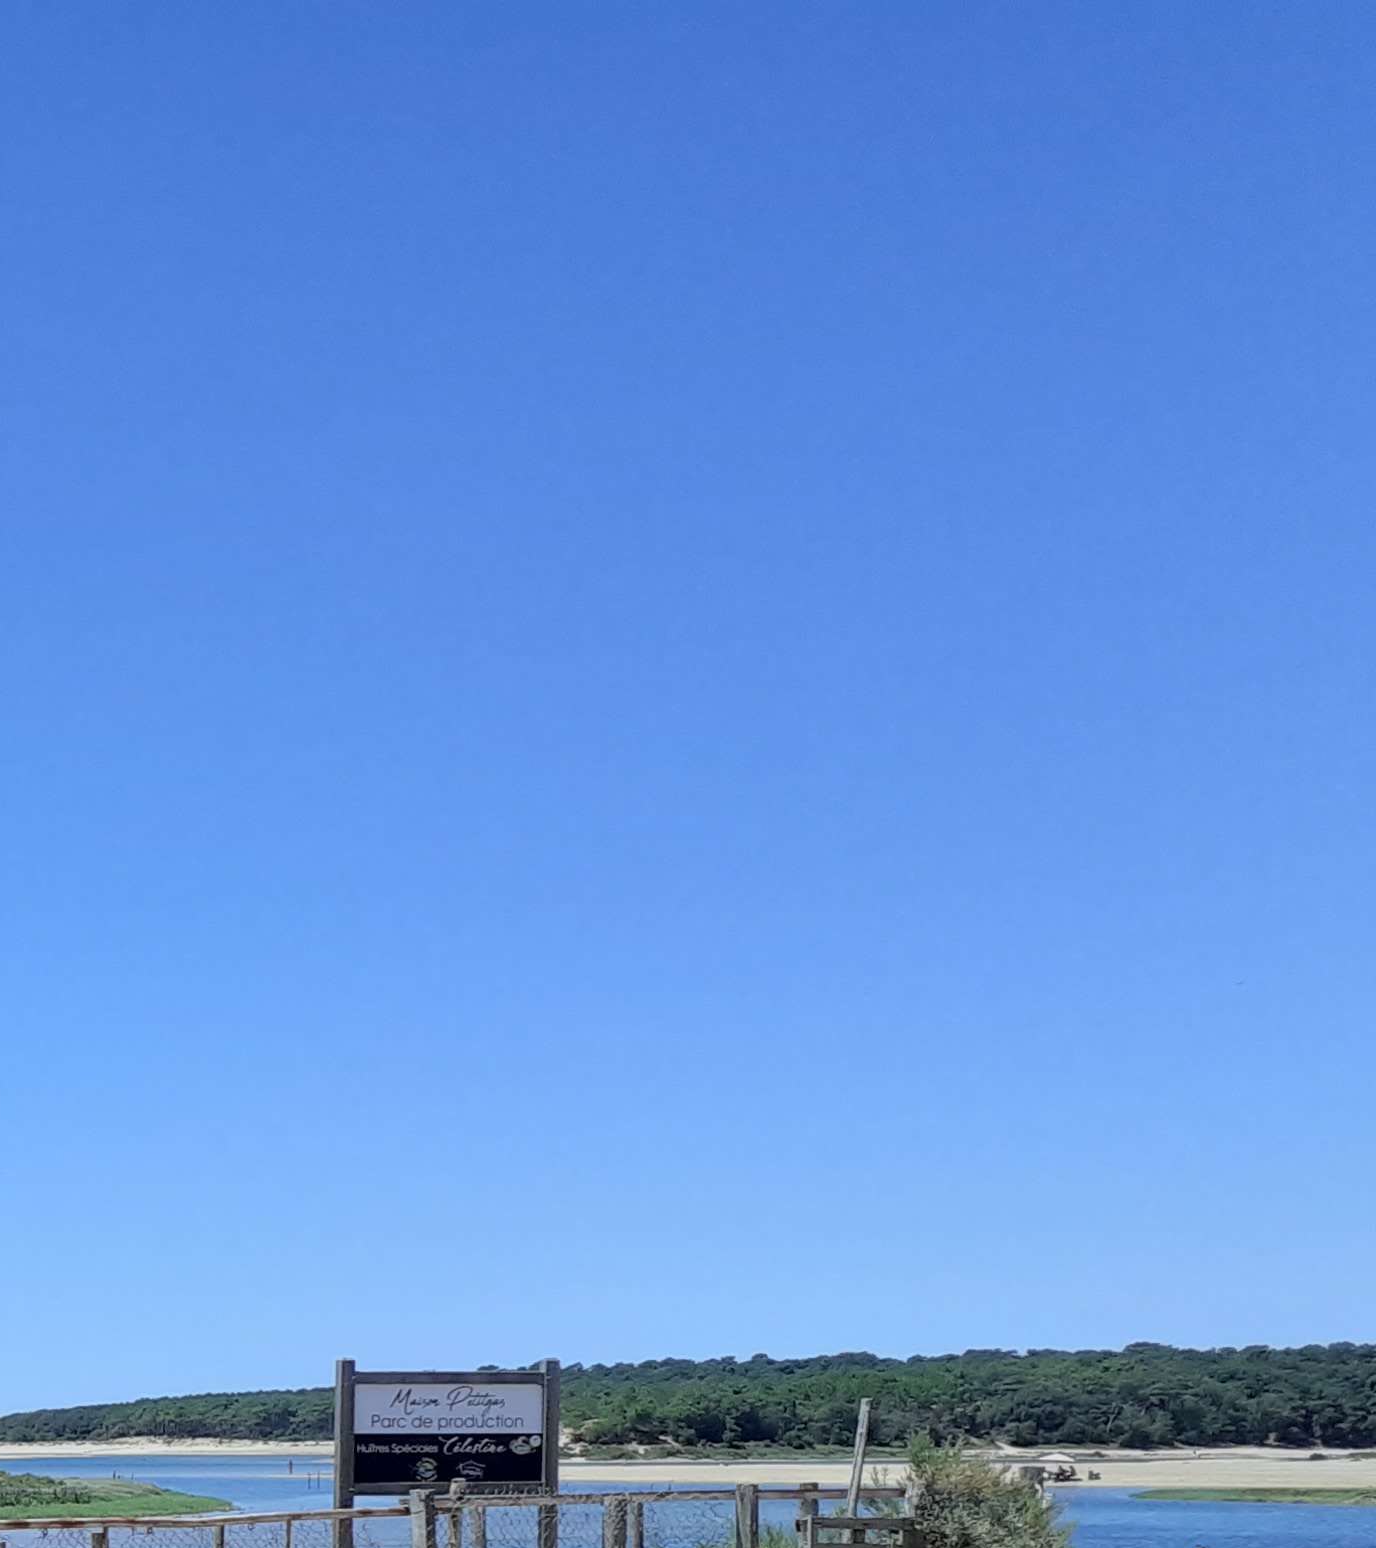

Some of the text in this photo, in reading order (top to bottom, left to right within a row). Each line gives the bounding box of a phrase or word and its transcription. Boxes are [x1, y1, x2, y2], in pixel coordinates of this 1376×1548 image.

[390, 1387, 440, 1415] Maison
[371, 1414, 524, 1430] Parc de production
[391, 1443, 438, 1454] Spéciales
